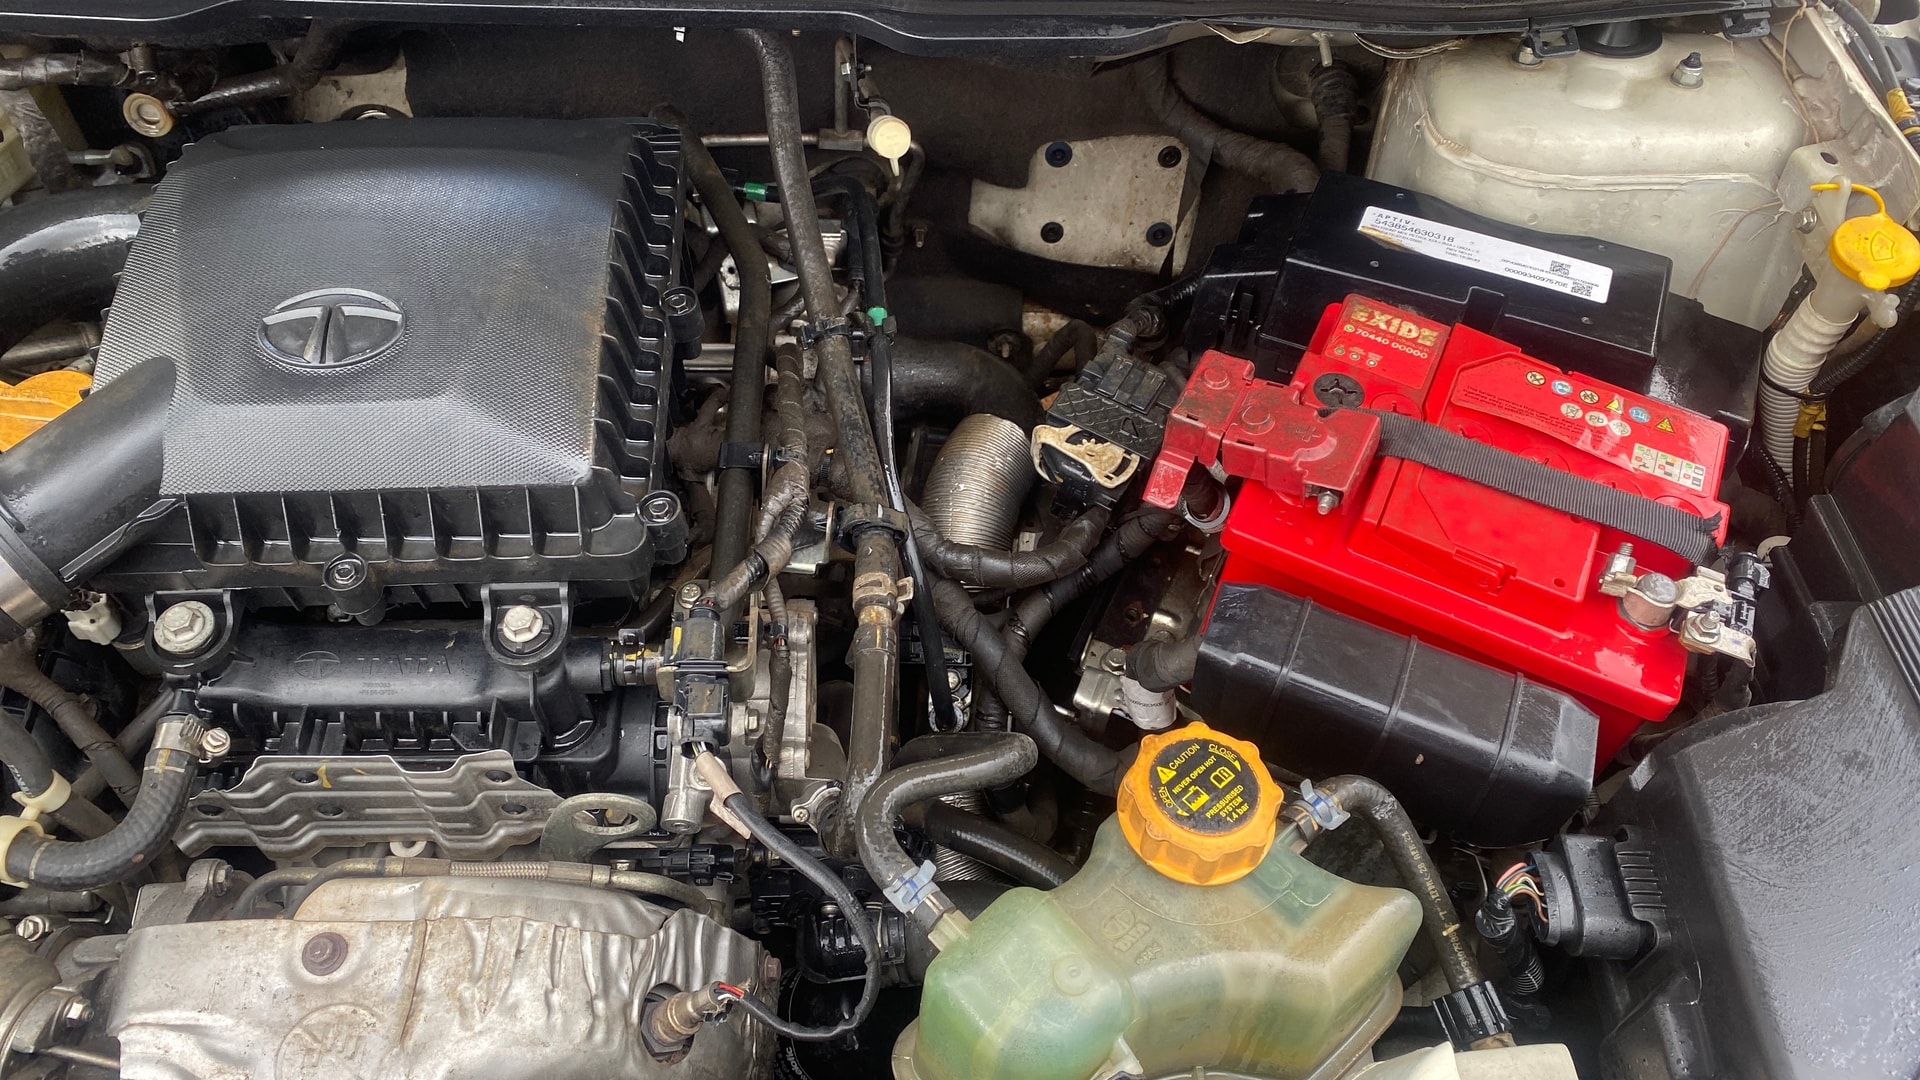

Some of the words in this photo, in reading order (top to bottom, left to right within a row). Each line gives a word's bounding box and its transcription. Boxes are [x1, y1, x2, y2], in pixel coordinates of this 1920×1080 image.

[1374, 218, 1455, 243] 543854630318
[1351, 304, 1440, 347] EXIDE
[1355, 328, 1390, 345] 70440
[1391, 341, 1428, 359] 00000
[1588, 414, 1605, 424] Pb
[1168, 742, 1200, 770] CAUTION
[1208, 743, 1238, 762] CLOSE
[1171, 776, 1193, 795] NEVER
[1189, 764, 1207, 780] OPEN
[1203, 755, 1217, 771] HOT
[1158, 786, 1174, 809] OPEN
[1205, 784, 1244, 819] PRESSURISED
[1219, 795, 1244, 818] SYSTEM
[1226, 812, 1239, 823] 1.4
[1236, 802, 1250, 816] bar
